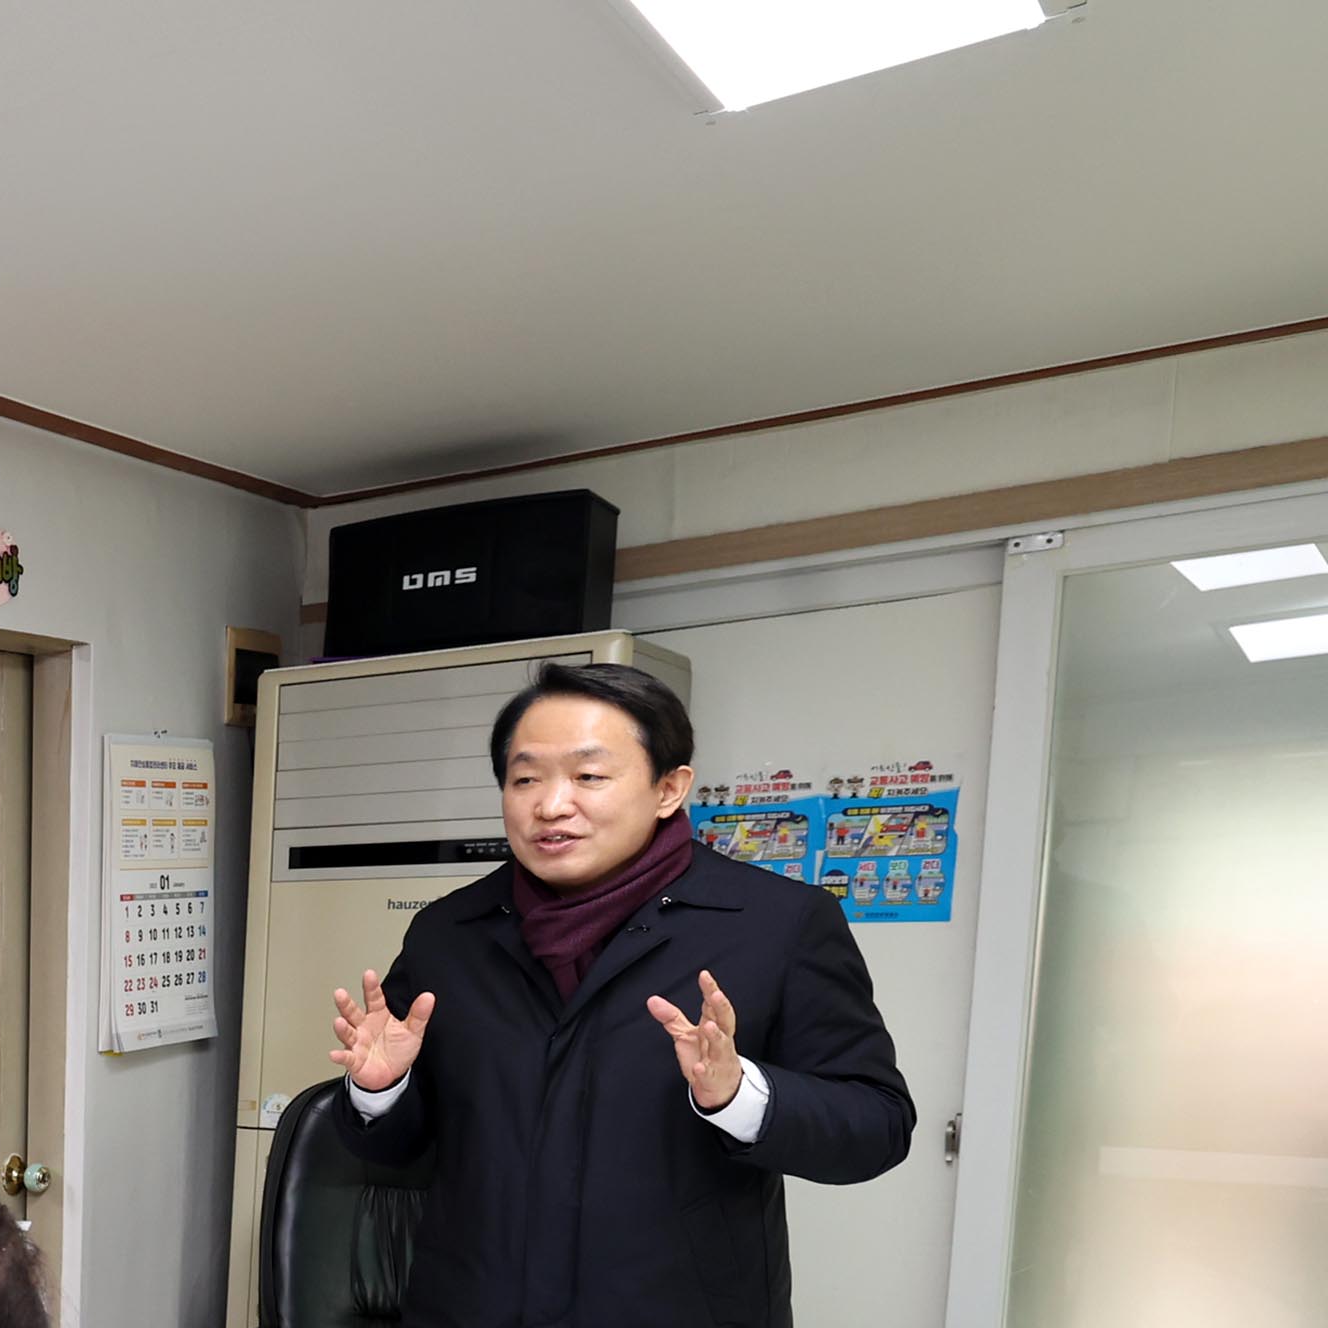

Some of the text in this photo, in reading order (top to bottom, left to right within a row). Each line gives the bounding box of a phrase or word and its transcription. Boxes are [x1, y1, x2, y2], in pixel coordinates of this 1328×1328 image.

[159, 874, 170, 891] 01
[137, 901, 204, 918] 2 3 5 6 7
[387, 899, 431, 910] hauze
[149, 925, 195, 941] 10 12 13
[149, 949, 195, 966] 17 20
[161, 972, 195, 988] 25 27
